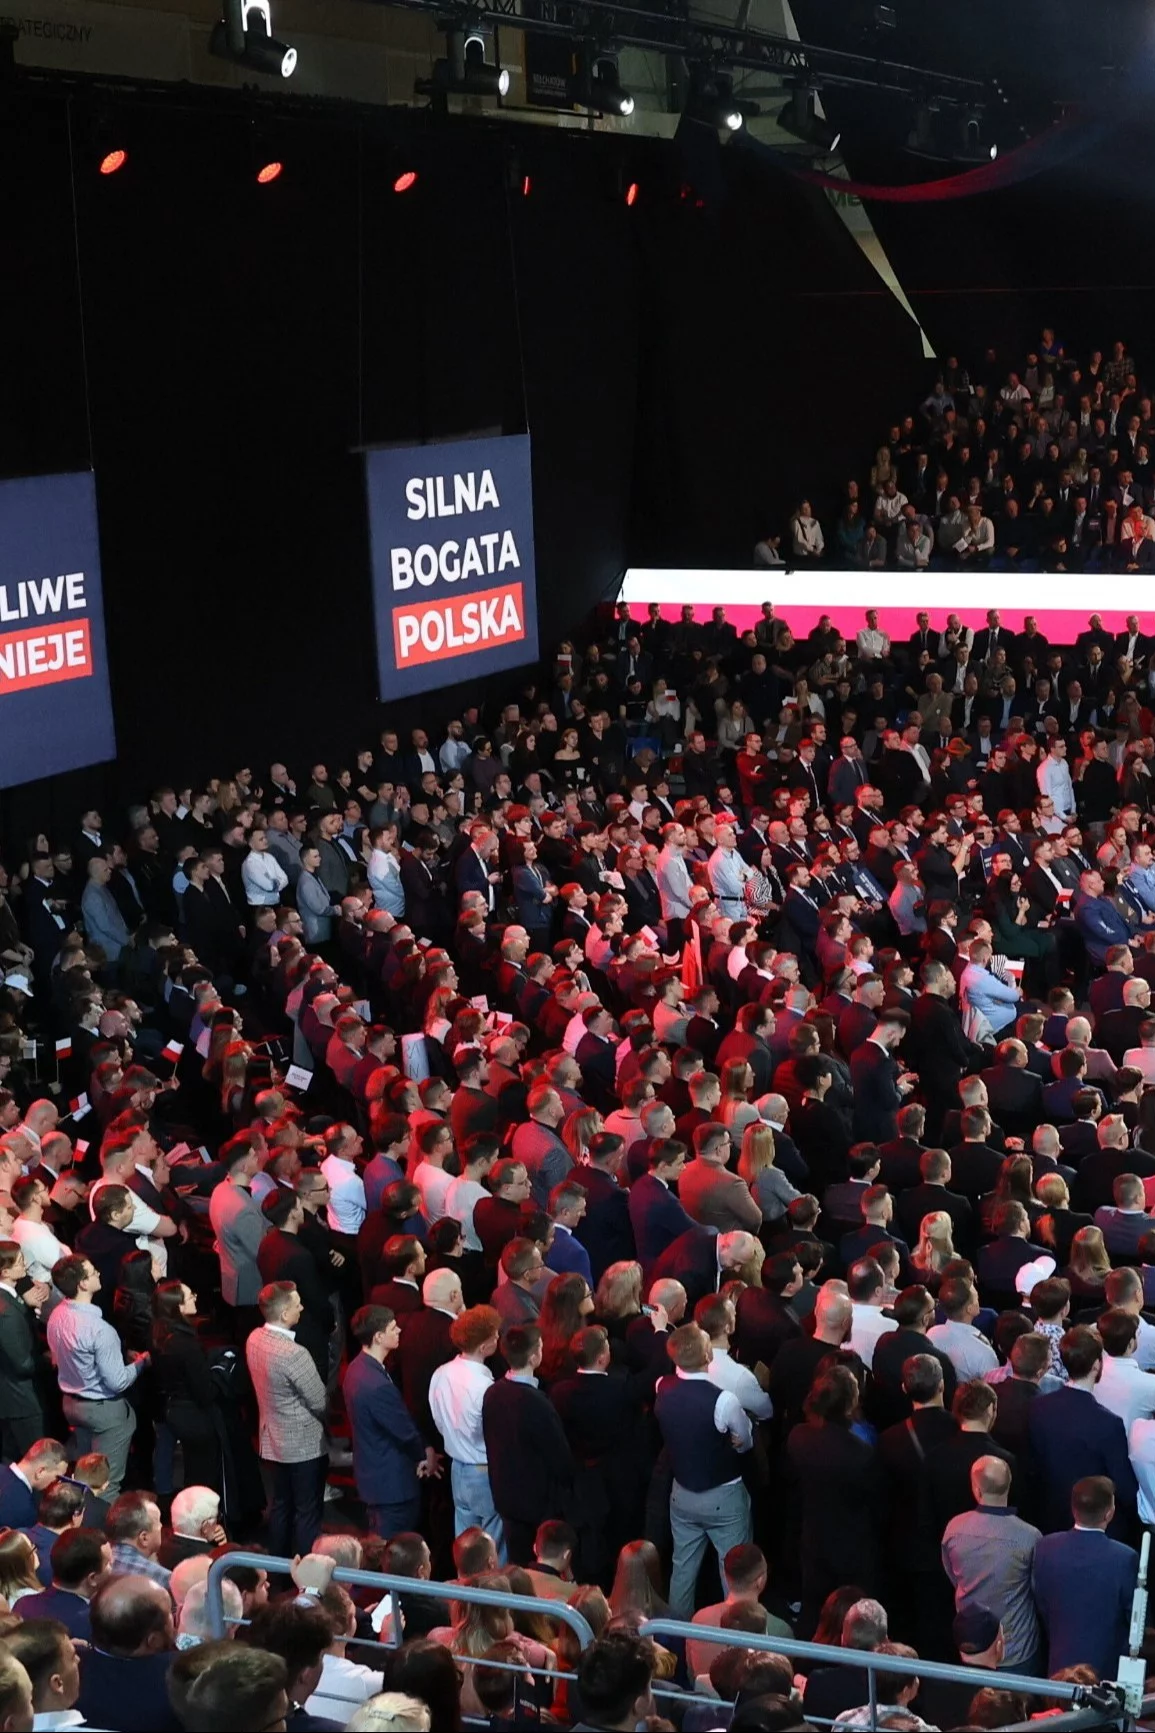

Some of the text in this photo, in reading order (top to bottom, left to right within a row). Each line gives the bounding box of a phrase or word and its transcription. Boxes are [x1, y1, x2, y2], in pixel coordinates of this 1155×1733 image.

[405, 469, 500, 520] SILNA
[390, 530, 521, 591] BOGATA
[0, 572, 87, 622] LIWE
[398, 594, 522, 658] POLSKA
